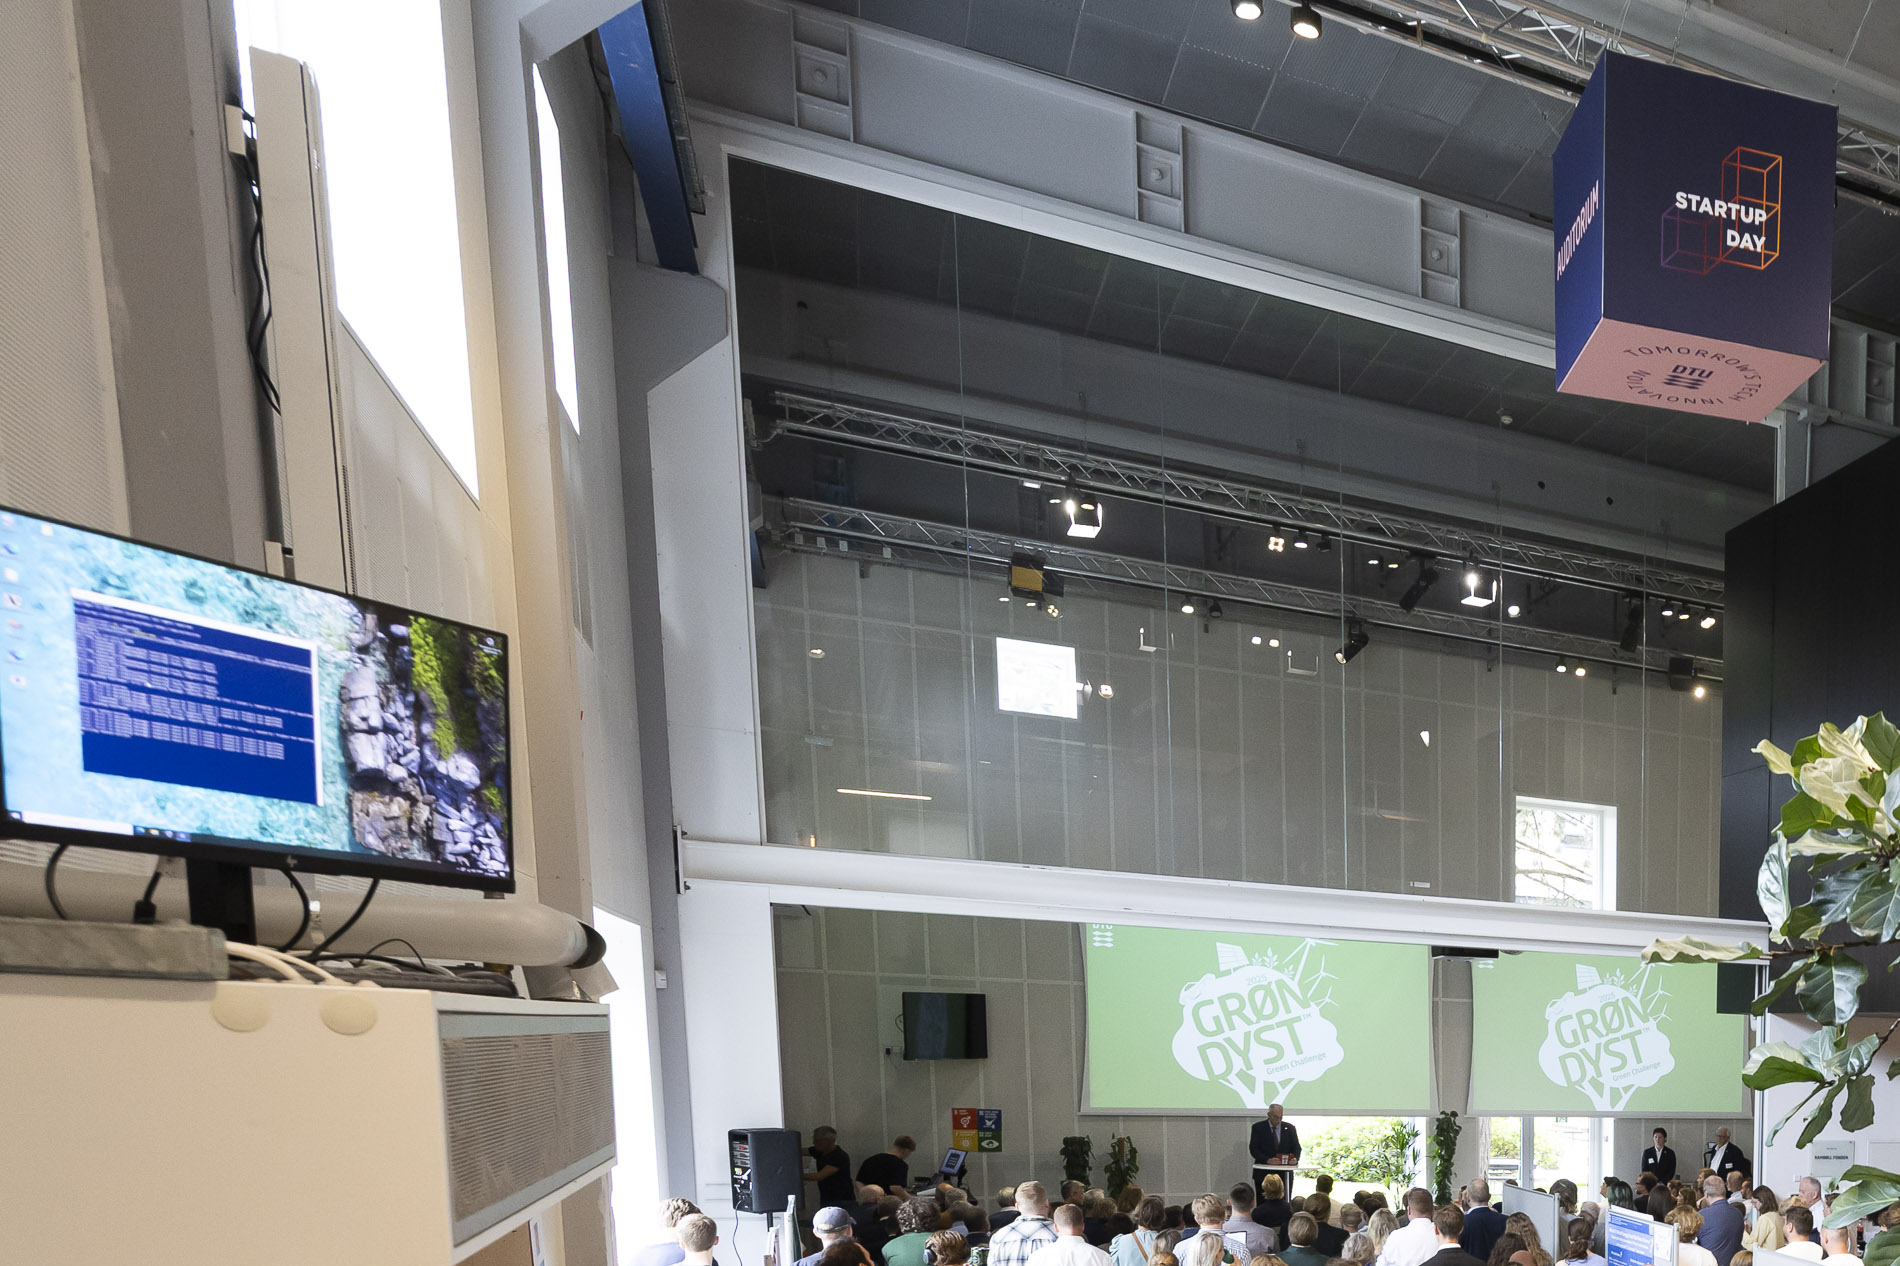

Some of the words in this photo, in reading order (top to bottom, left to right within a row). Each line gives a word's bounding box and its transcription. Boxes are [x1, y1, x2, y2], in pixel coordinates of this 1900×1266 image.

[1675, 191, 1767, 226] STARTUP
[1556, 179, 1599, 281] AUDITORIUM
[1726, 229, 1766, 252] DAY
[1626, 369, 1724, 405] INNOVATION
[1671, 364, 1714, 379] DTU
[1191, 978, 1311, 1038] GRØN
[1555, 996, 1650, 1049] GRØN
[1266, 1062, 1289, 1076] Green
[1290, 1051, 1327, 1069] Challenge
[1612, 1070, 1631, 1082] Green
[1632, 1061, 1661, 1076] Challenge
